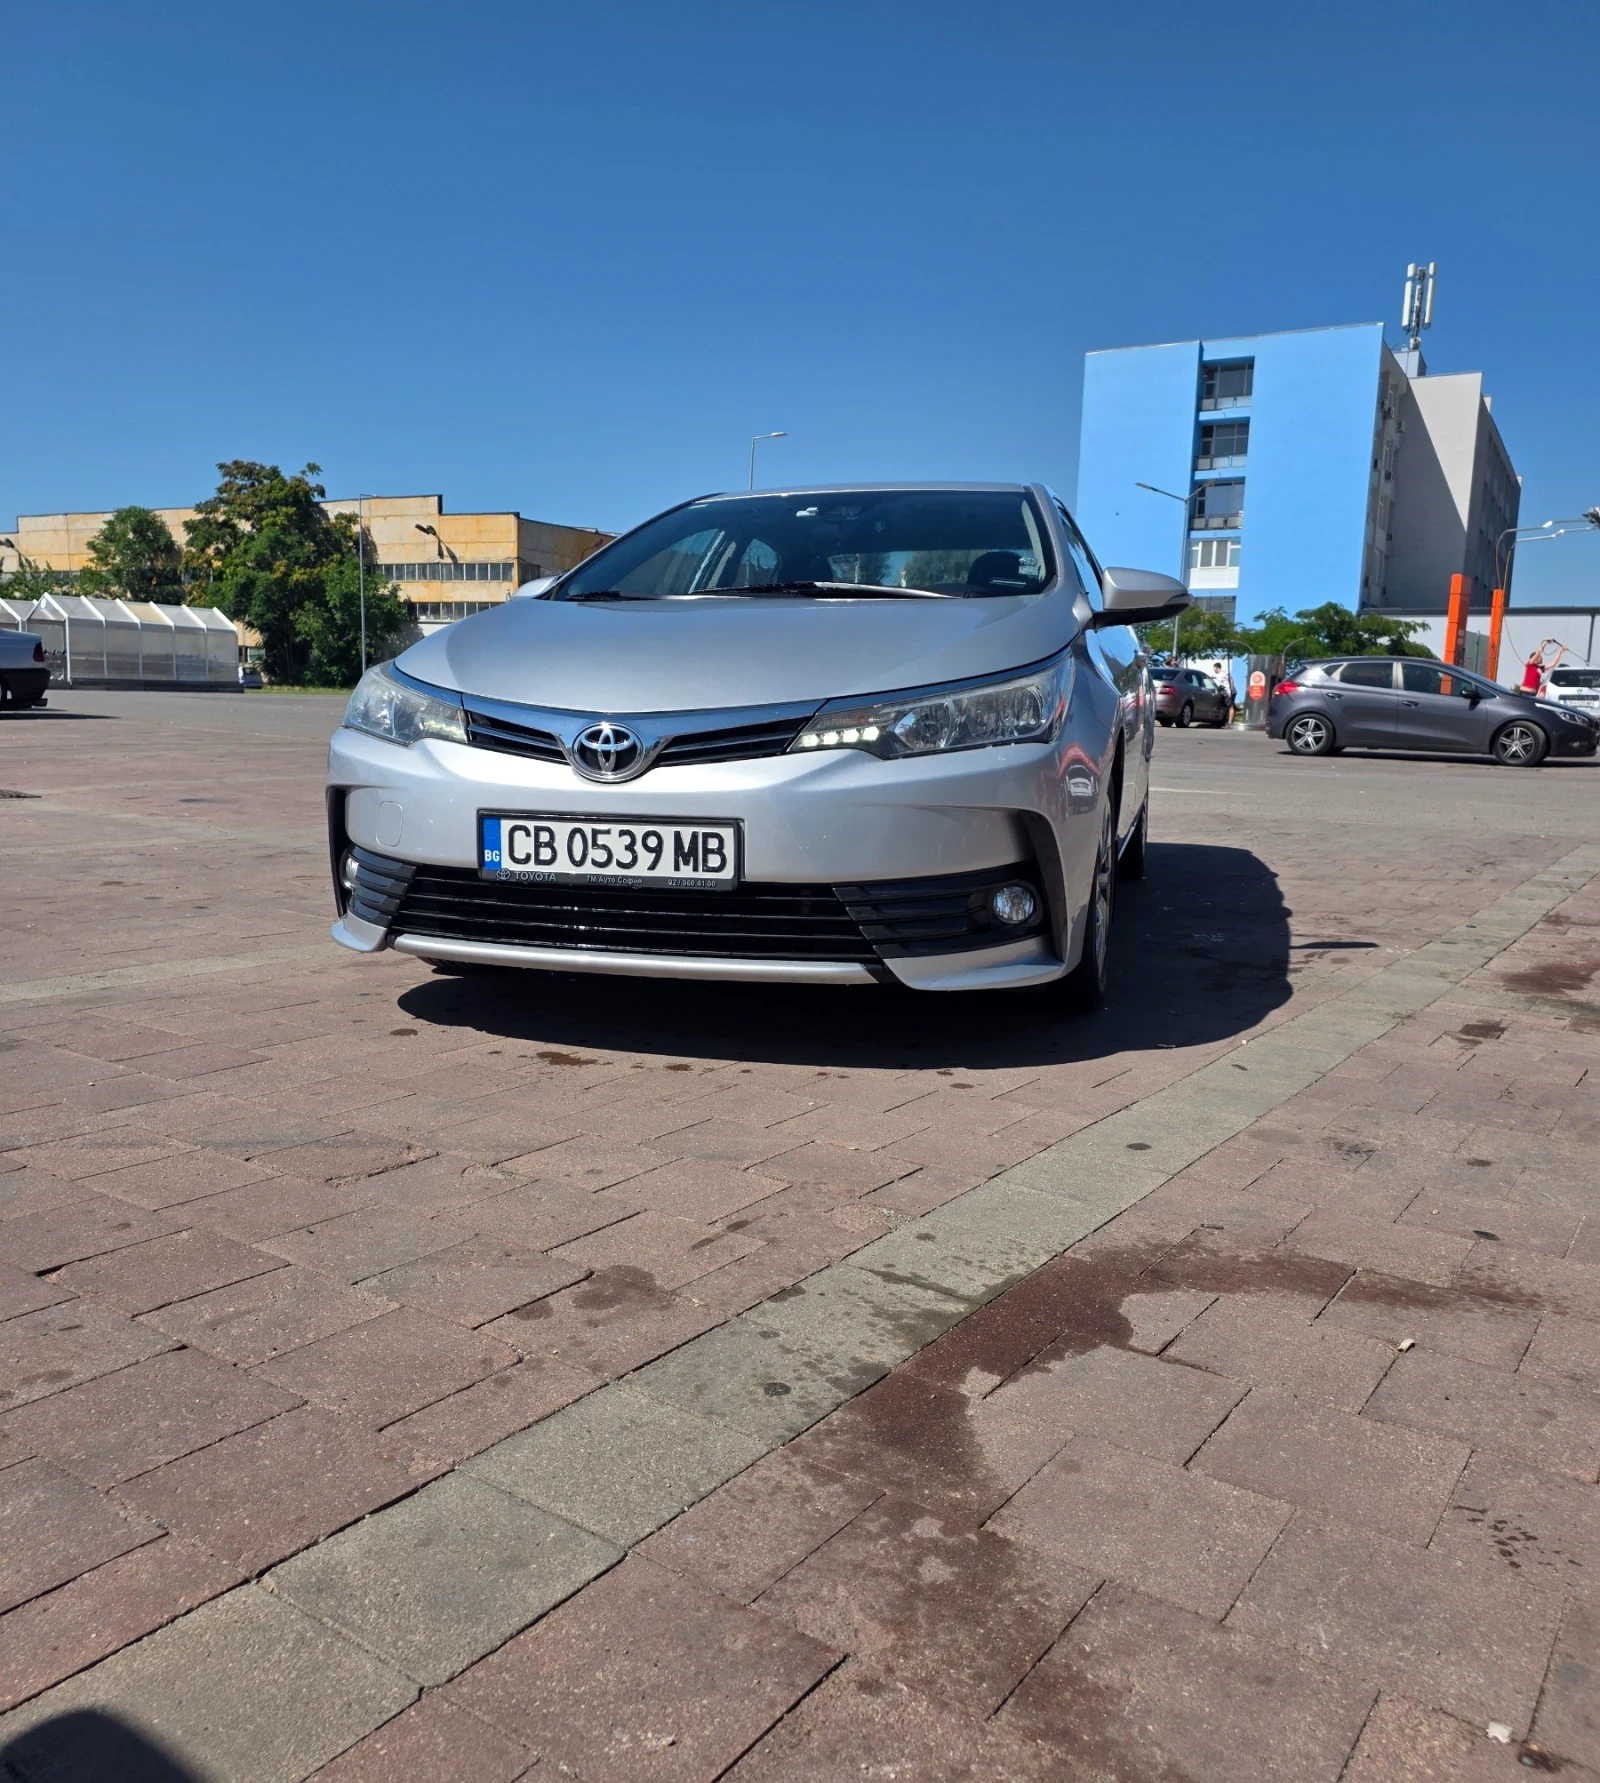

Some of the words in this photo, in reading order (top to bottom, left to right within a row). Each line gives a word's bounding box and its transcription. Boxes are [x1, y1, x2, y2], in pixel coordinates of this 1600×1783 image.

[508, 824, 557, 866] CB
[567, 827, 664, 871] 0539
[673, 830, 727, 873] MB
[484, 849, 501, 862] BG
[514, 871, 557, 882] TOYOTA
[617, 876, 643, 885] София
